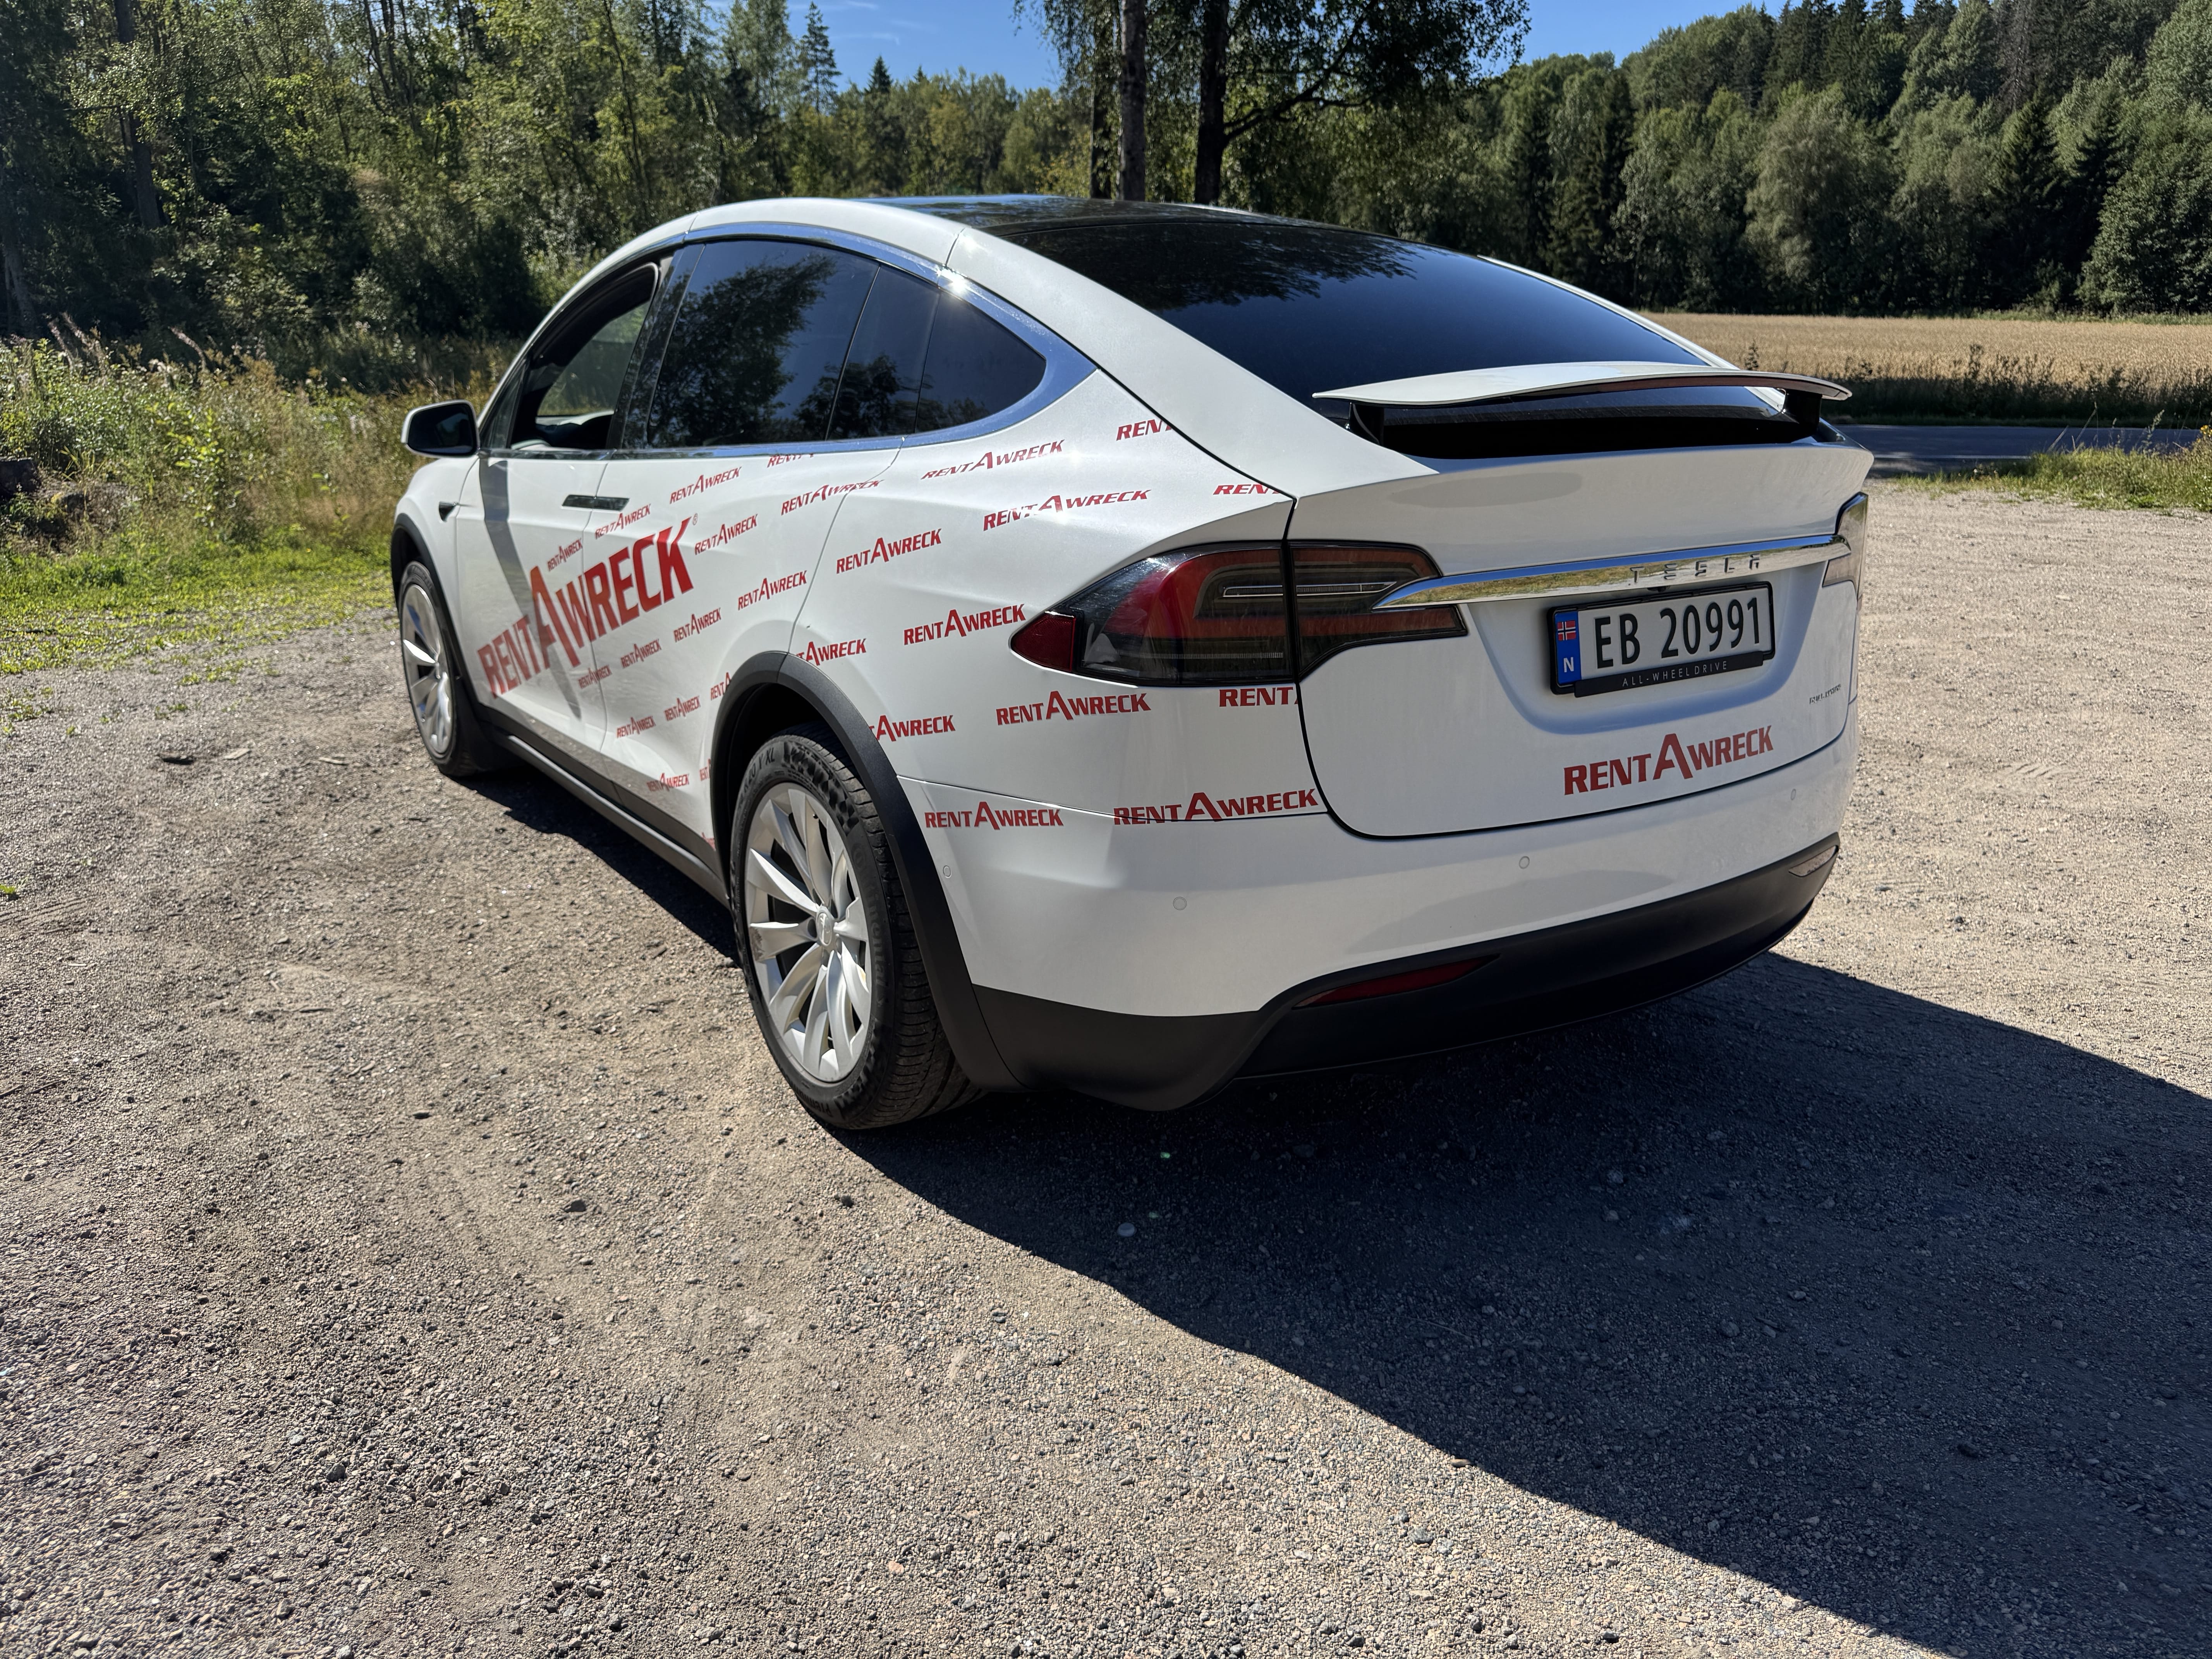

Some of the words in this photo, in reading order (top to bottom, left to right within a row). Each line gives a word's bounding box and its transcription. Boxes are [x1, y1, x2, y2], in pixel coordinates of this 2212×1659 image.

[921, 439, 1064, 479] RENTAWRECK
[670, 467, 742, 504] RENTAWRECK
[781, 479, 885, 515] RENTAWRECK
[595, 504, 651, 539] RENTAWRECK
[983, 489, 1152, 531] RENTAWRECK
[694, 514, 758, 555] RENTAWRECK
[836, 528, 942, 574] RENTAWRECK
[547, 538, 583, 572] RENTAWRECK
[1630, 553, 1761, 583] TESLA
[738, 570, 807, 611] RENTAWRECK
[673, 608, 721, 643] RENTAWRECK
[904, 604, 1026, 646] RENTAWRECK
[1594, 613, 1640, 669] EB
[1660, 597, 1760, 658] 20991
[620, 639, 662, 669] RENTAWRECK
[1563, 656, 1574, 673] N
[664, 695, 701, 721] RENTAWRECK
[996, 690, 1151, 726] RENTAWRECK
[616, 715, 656, 738] RENTAWRECK
[1563, 725, 1774, 796] RENTAWRECK
[924, 801, 1064, 830] RENTAWRECK
[1113, 788, 1319, 826] RENTAWRECK
